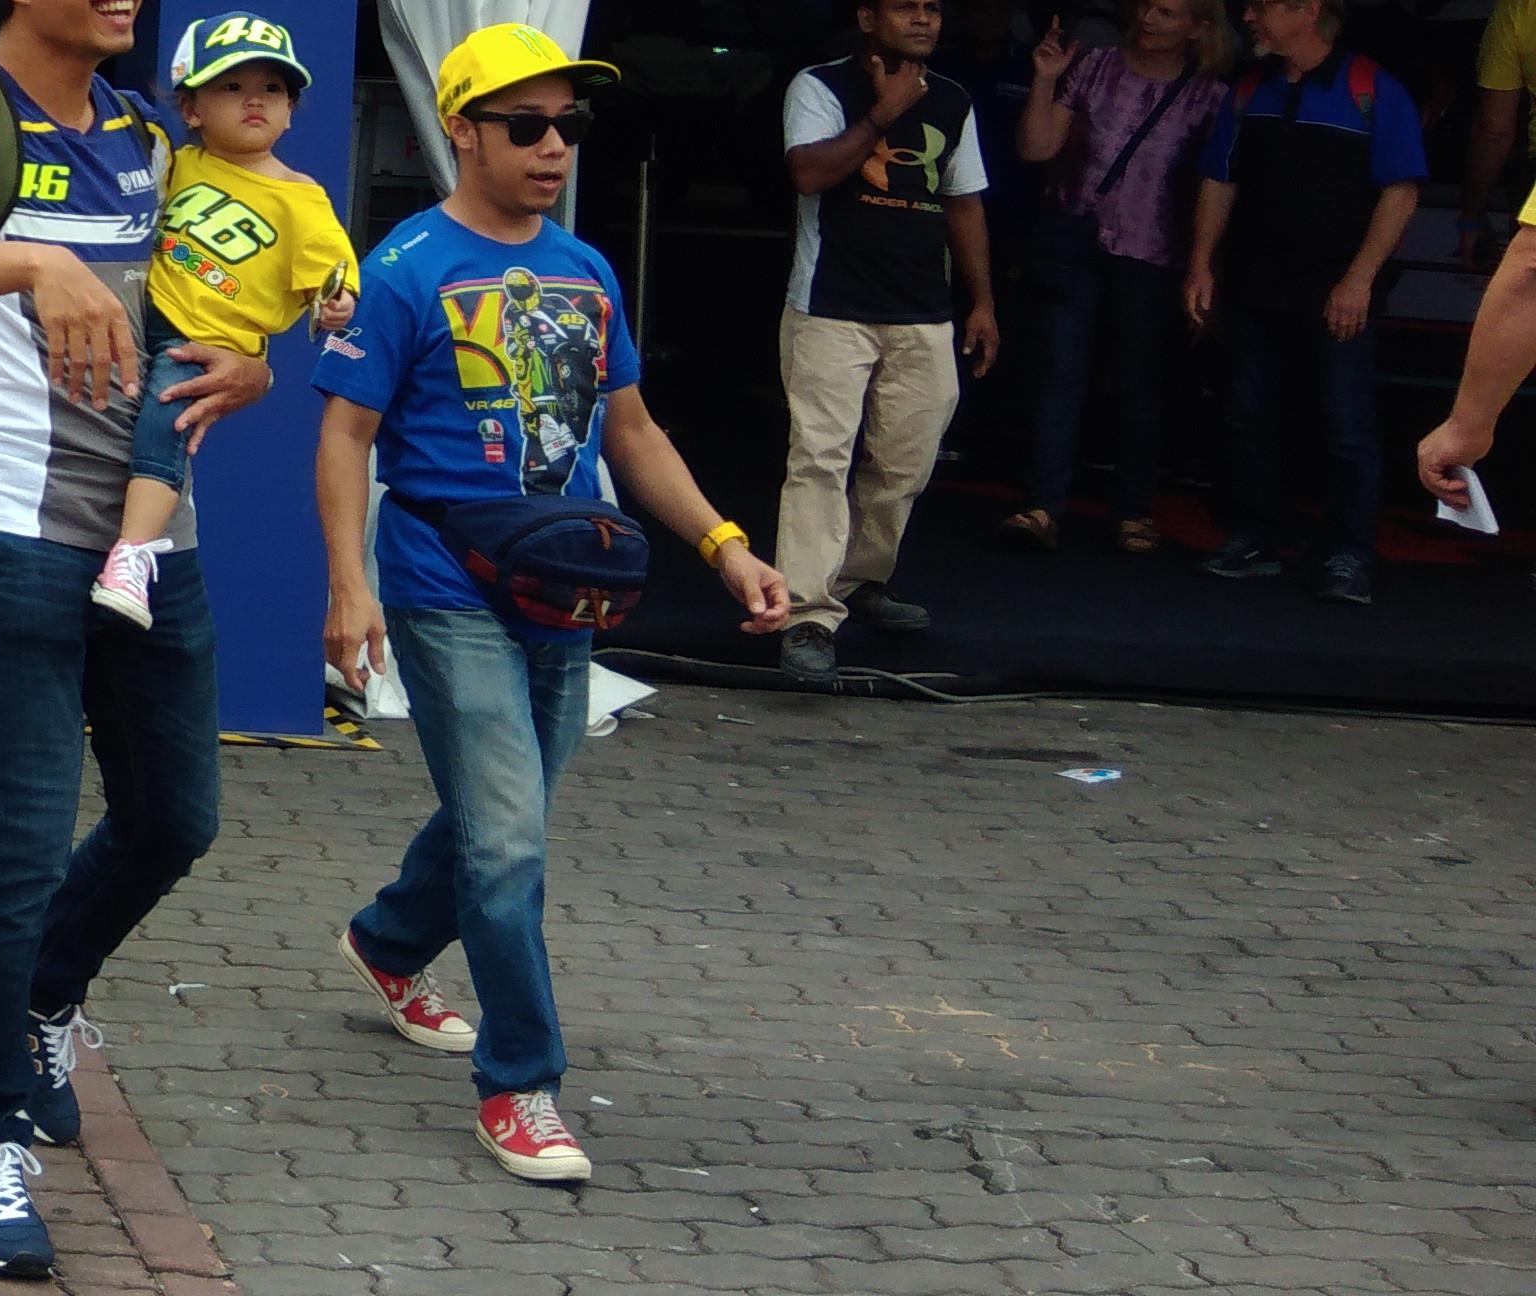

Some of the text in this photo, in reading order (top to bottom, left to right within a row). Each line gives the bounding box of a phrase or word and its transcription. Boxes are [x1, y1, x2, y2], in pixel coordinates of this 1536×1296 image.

[204, 17, 284, 50] 46
[161, 181, 278, 266] 46
[159, 235, 241, 301] DOCTOR
